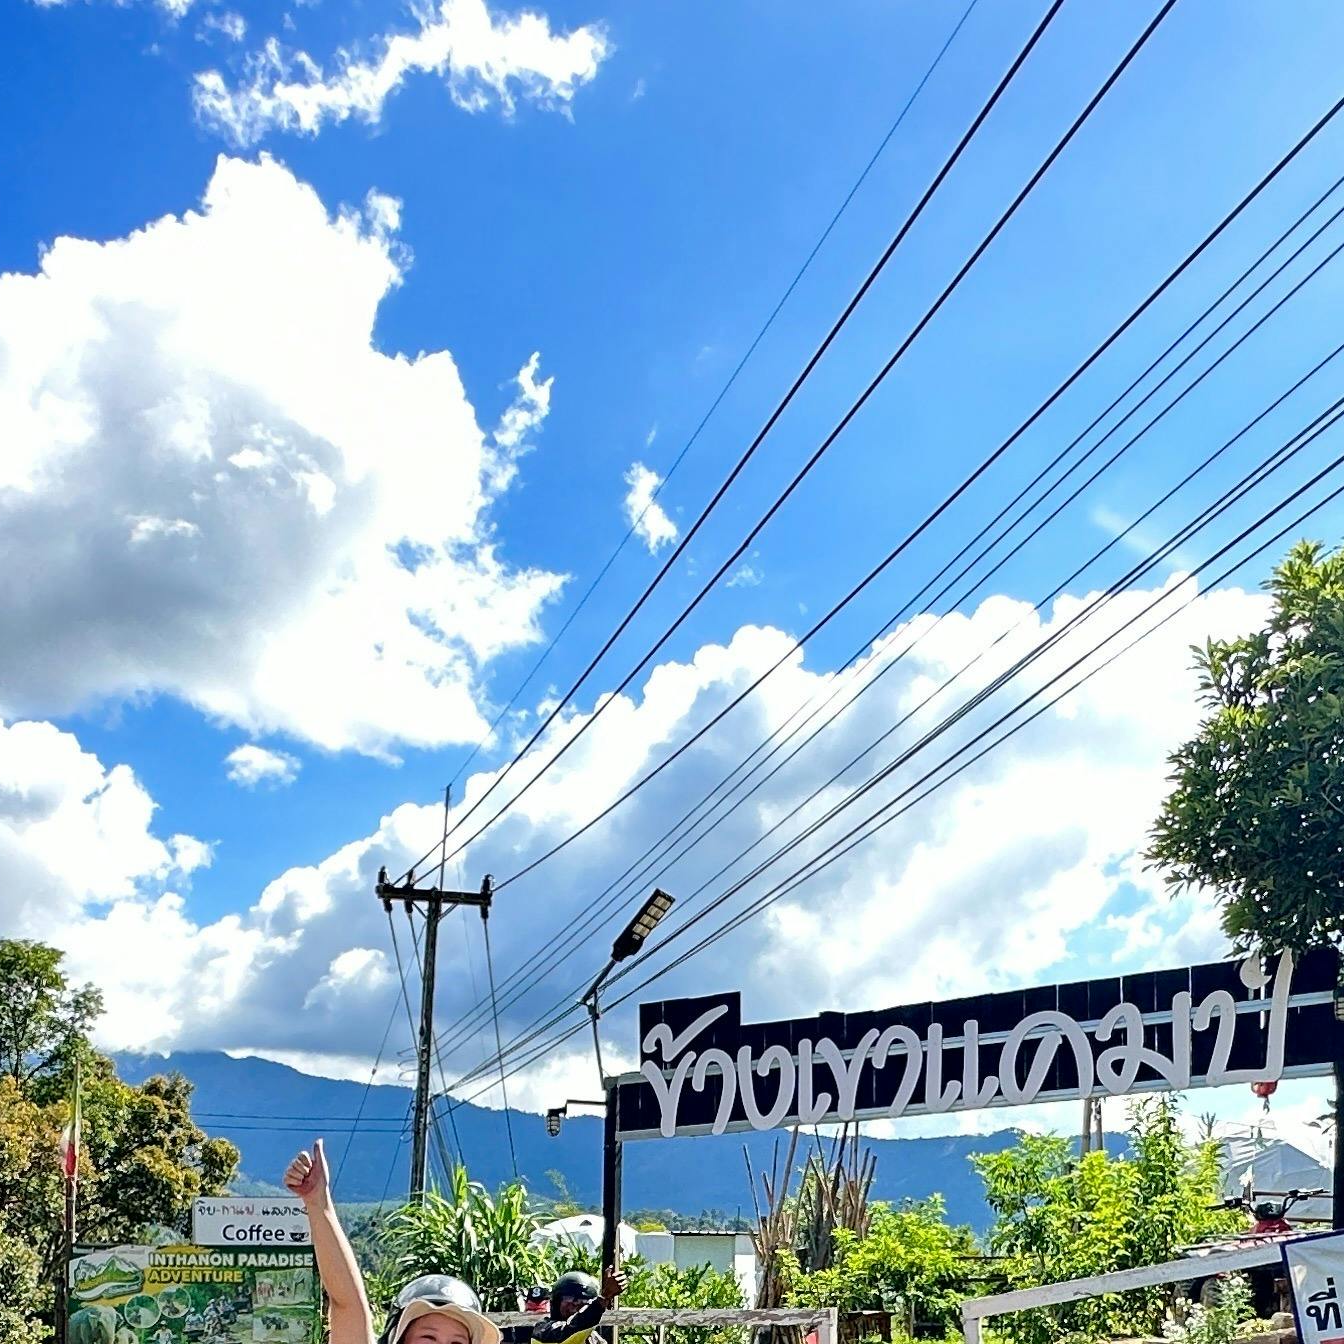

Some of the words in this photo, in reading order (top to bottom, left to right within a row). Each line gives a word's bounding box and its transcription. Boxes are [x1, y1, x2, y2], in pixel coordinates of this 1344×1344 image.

[222, 1224, 285, 1241] Coffee
[149, 1253, 234, 1267] INTHANON
[238, 1253, 314, 1267] PARADISE
[149, 1270, 244, 1283] ADVENTURE
